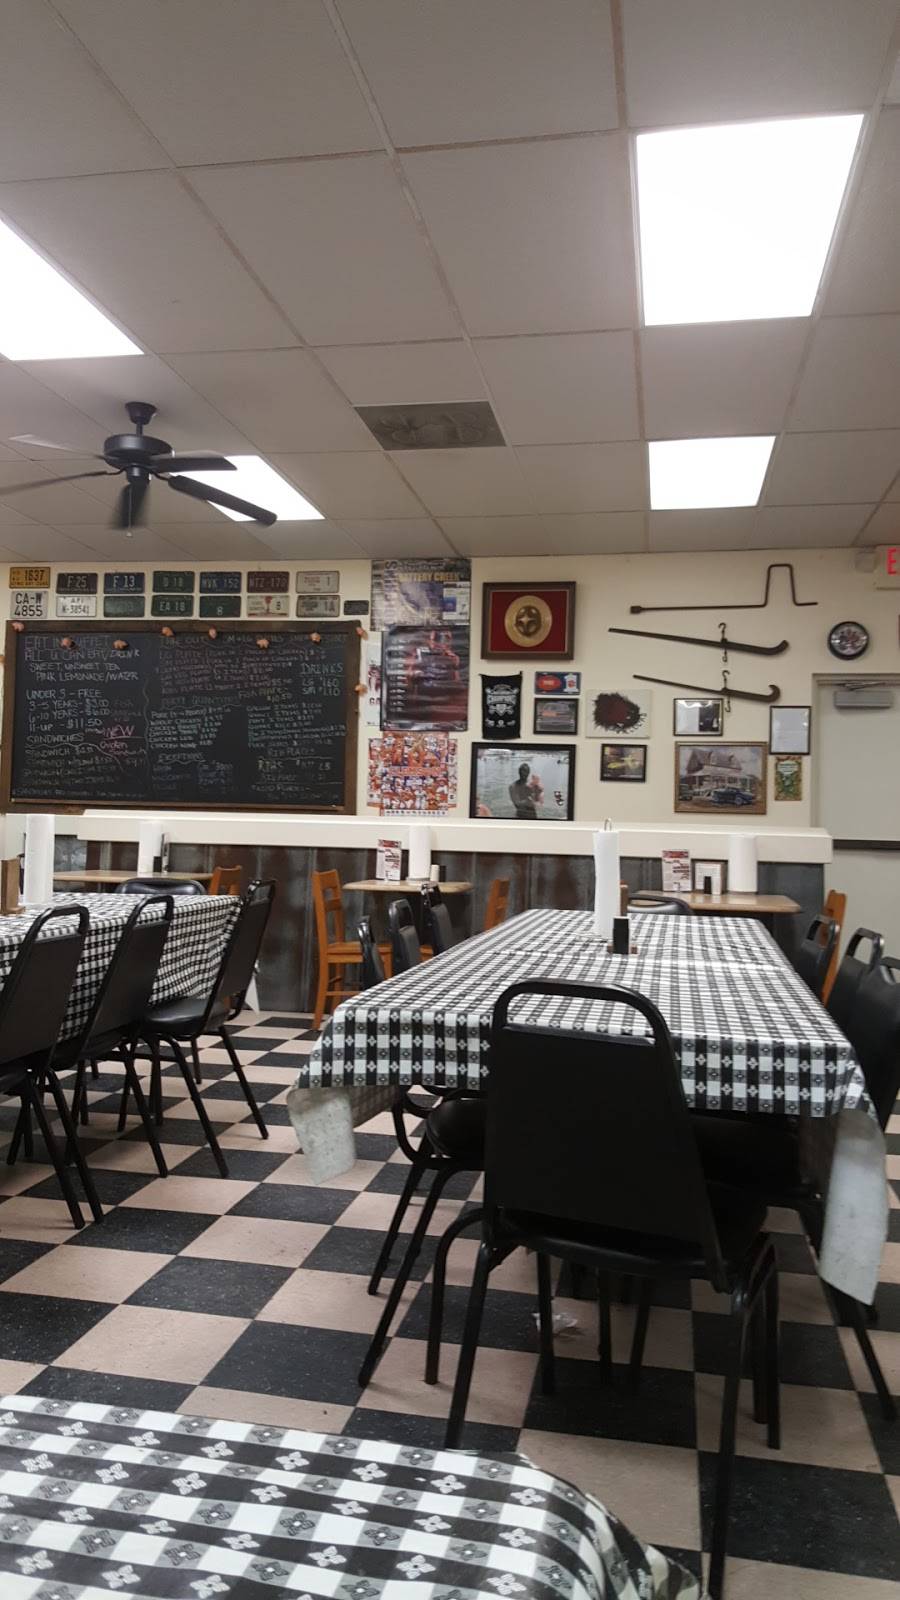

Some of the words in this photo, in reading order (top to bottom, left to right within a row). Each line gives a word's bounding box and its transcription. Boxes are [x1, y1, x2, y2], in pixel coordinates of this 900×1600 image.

[24, 569, 45, 583] 1637
[14, 605, 43, 617] 4855
[26, 688, 56, 700] UNDER
[78, 688, 103, 698] FREE
